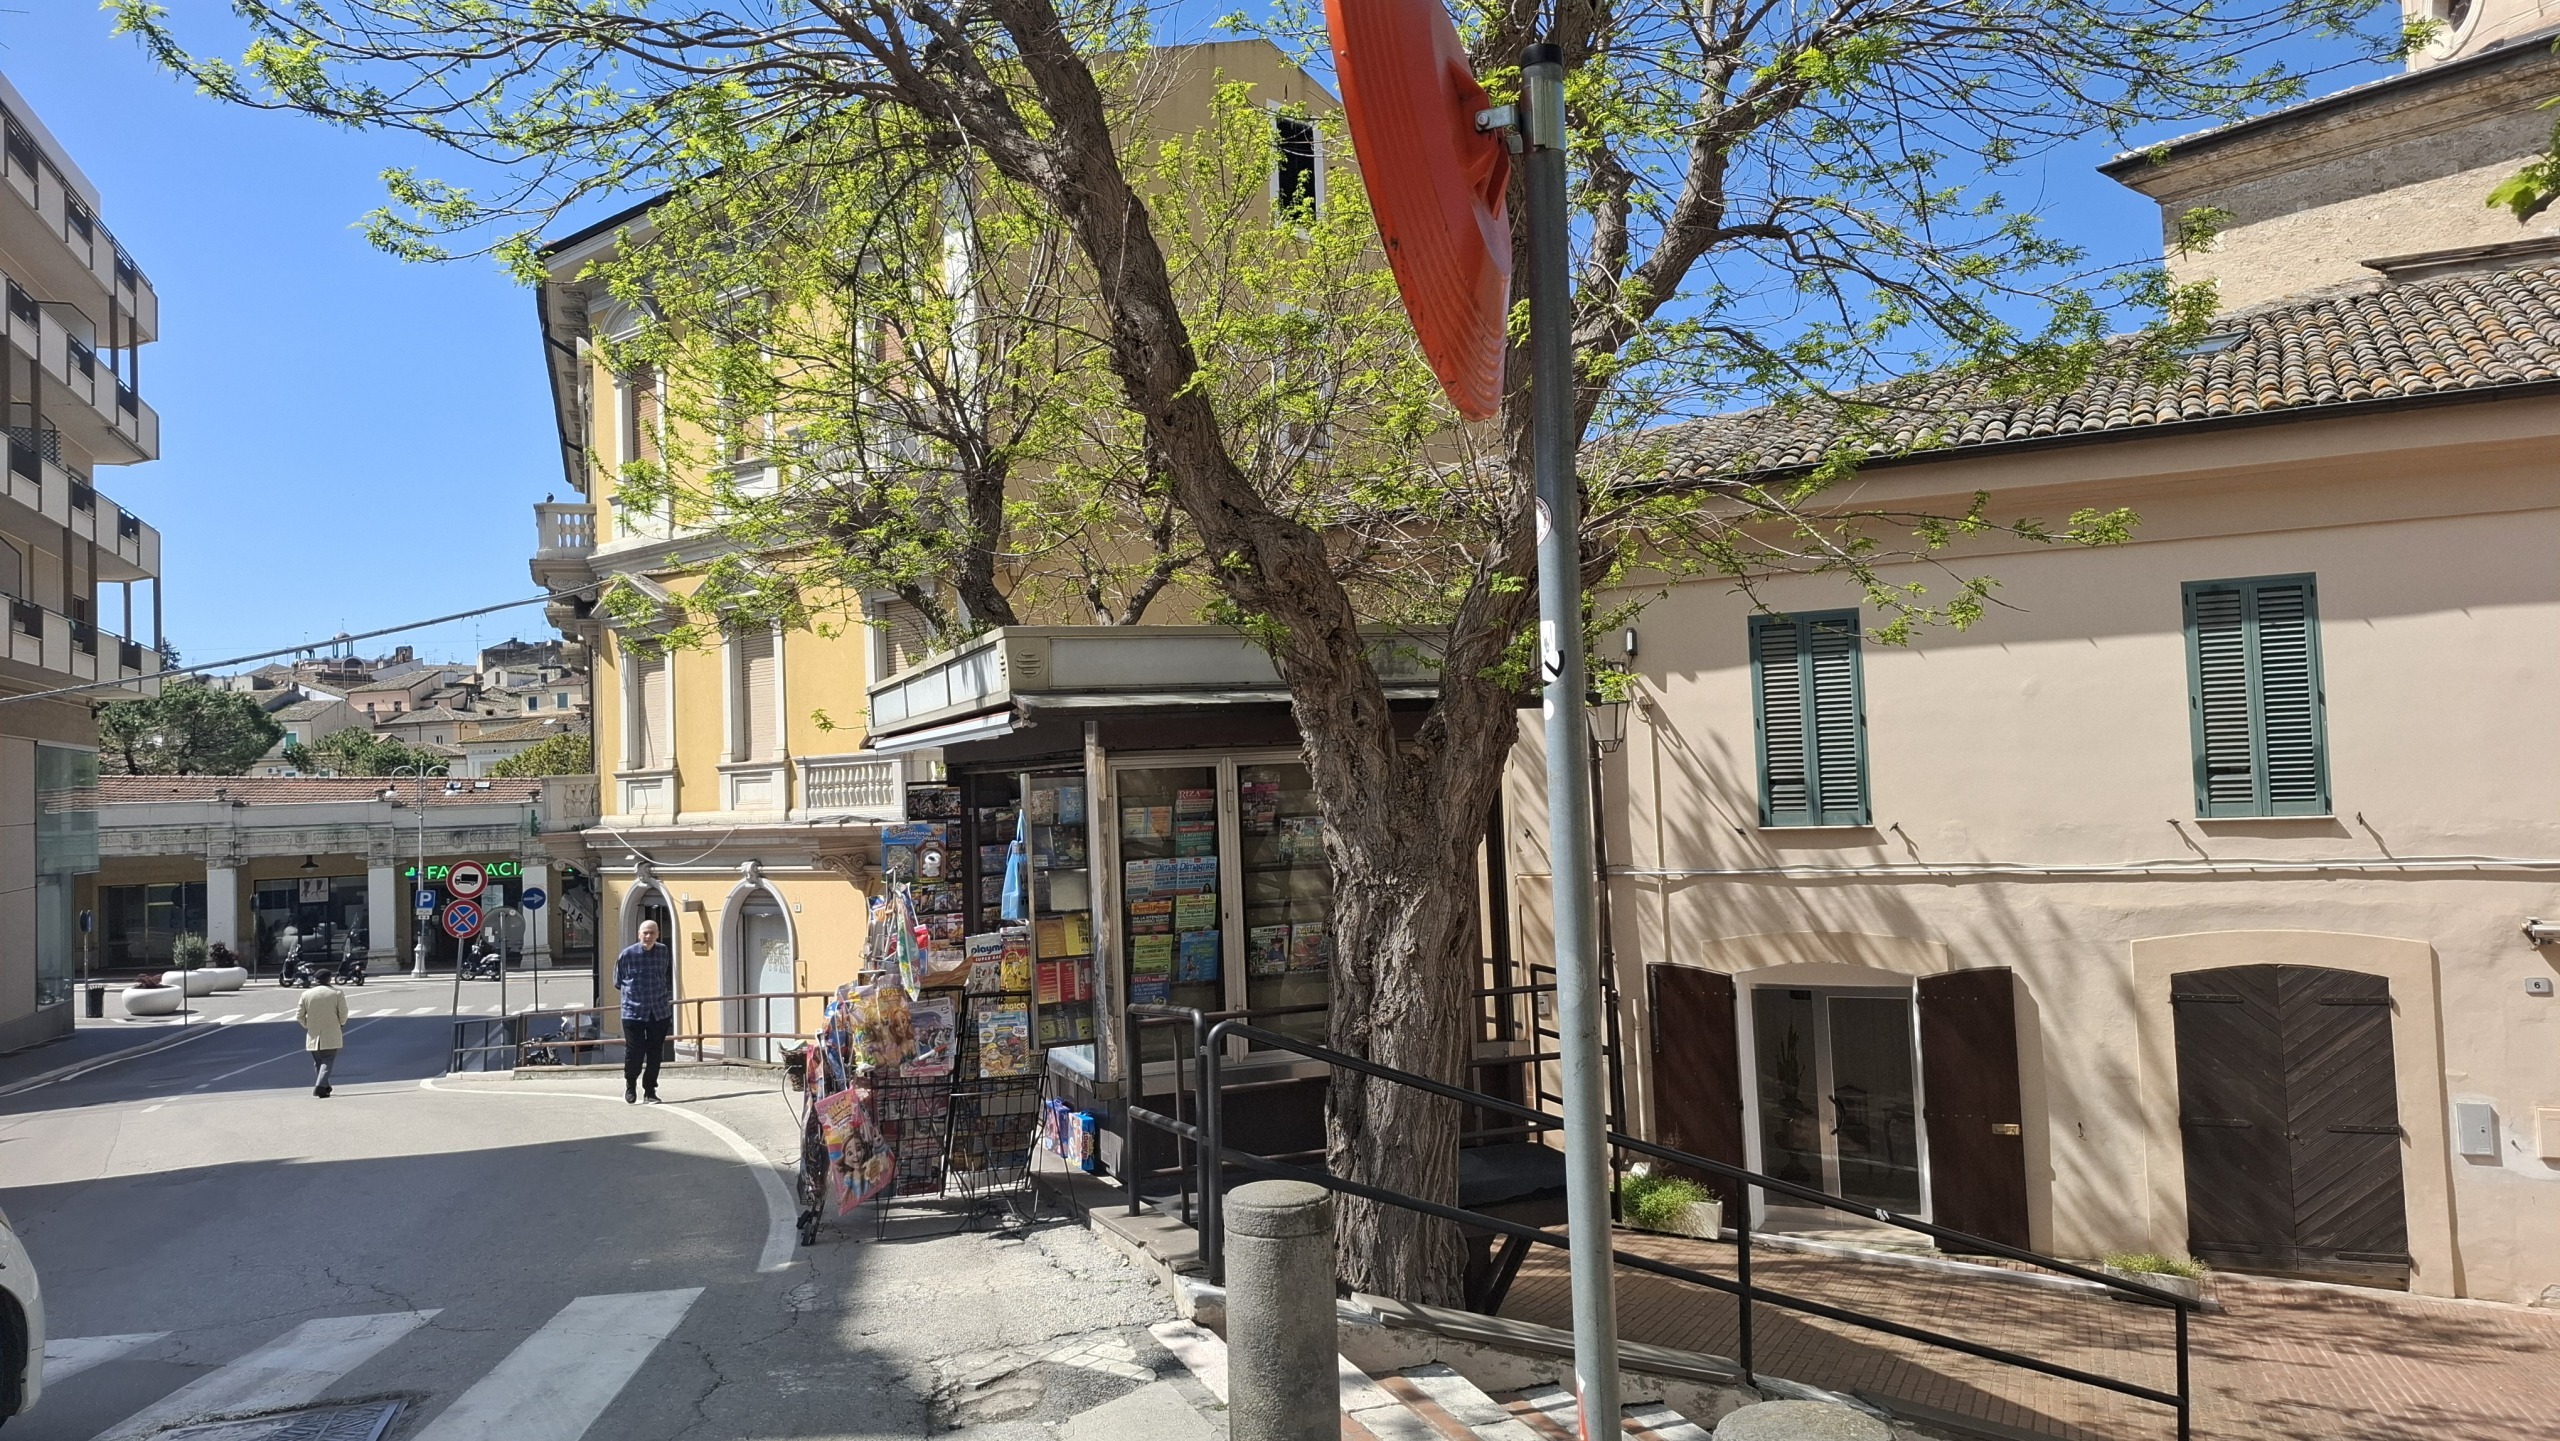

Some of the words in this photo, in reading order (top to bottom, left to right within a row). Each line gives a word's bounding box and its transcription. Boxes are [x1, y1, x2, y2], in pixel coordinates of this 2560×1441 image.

[1179, 790, 1201, 799] RIZA
[428, 862, 523, 879] FAACI
[1180, 861, 1215, 872] Dimagrire
[420, 892, 432, 907] P
[2534, 981, 2541, 989] 6
